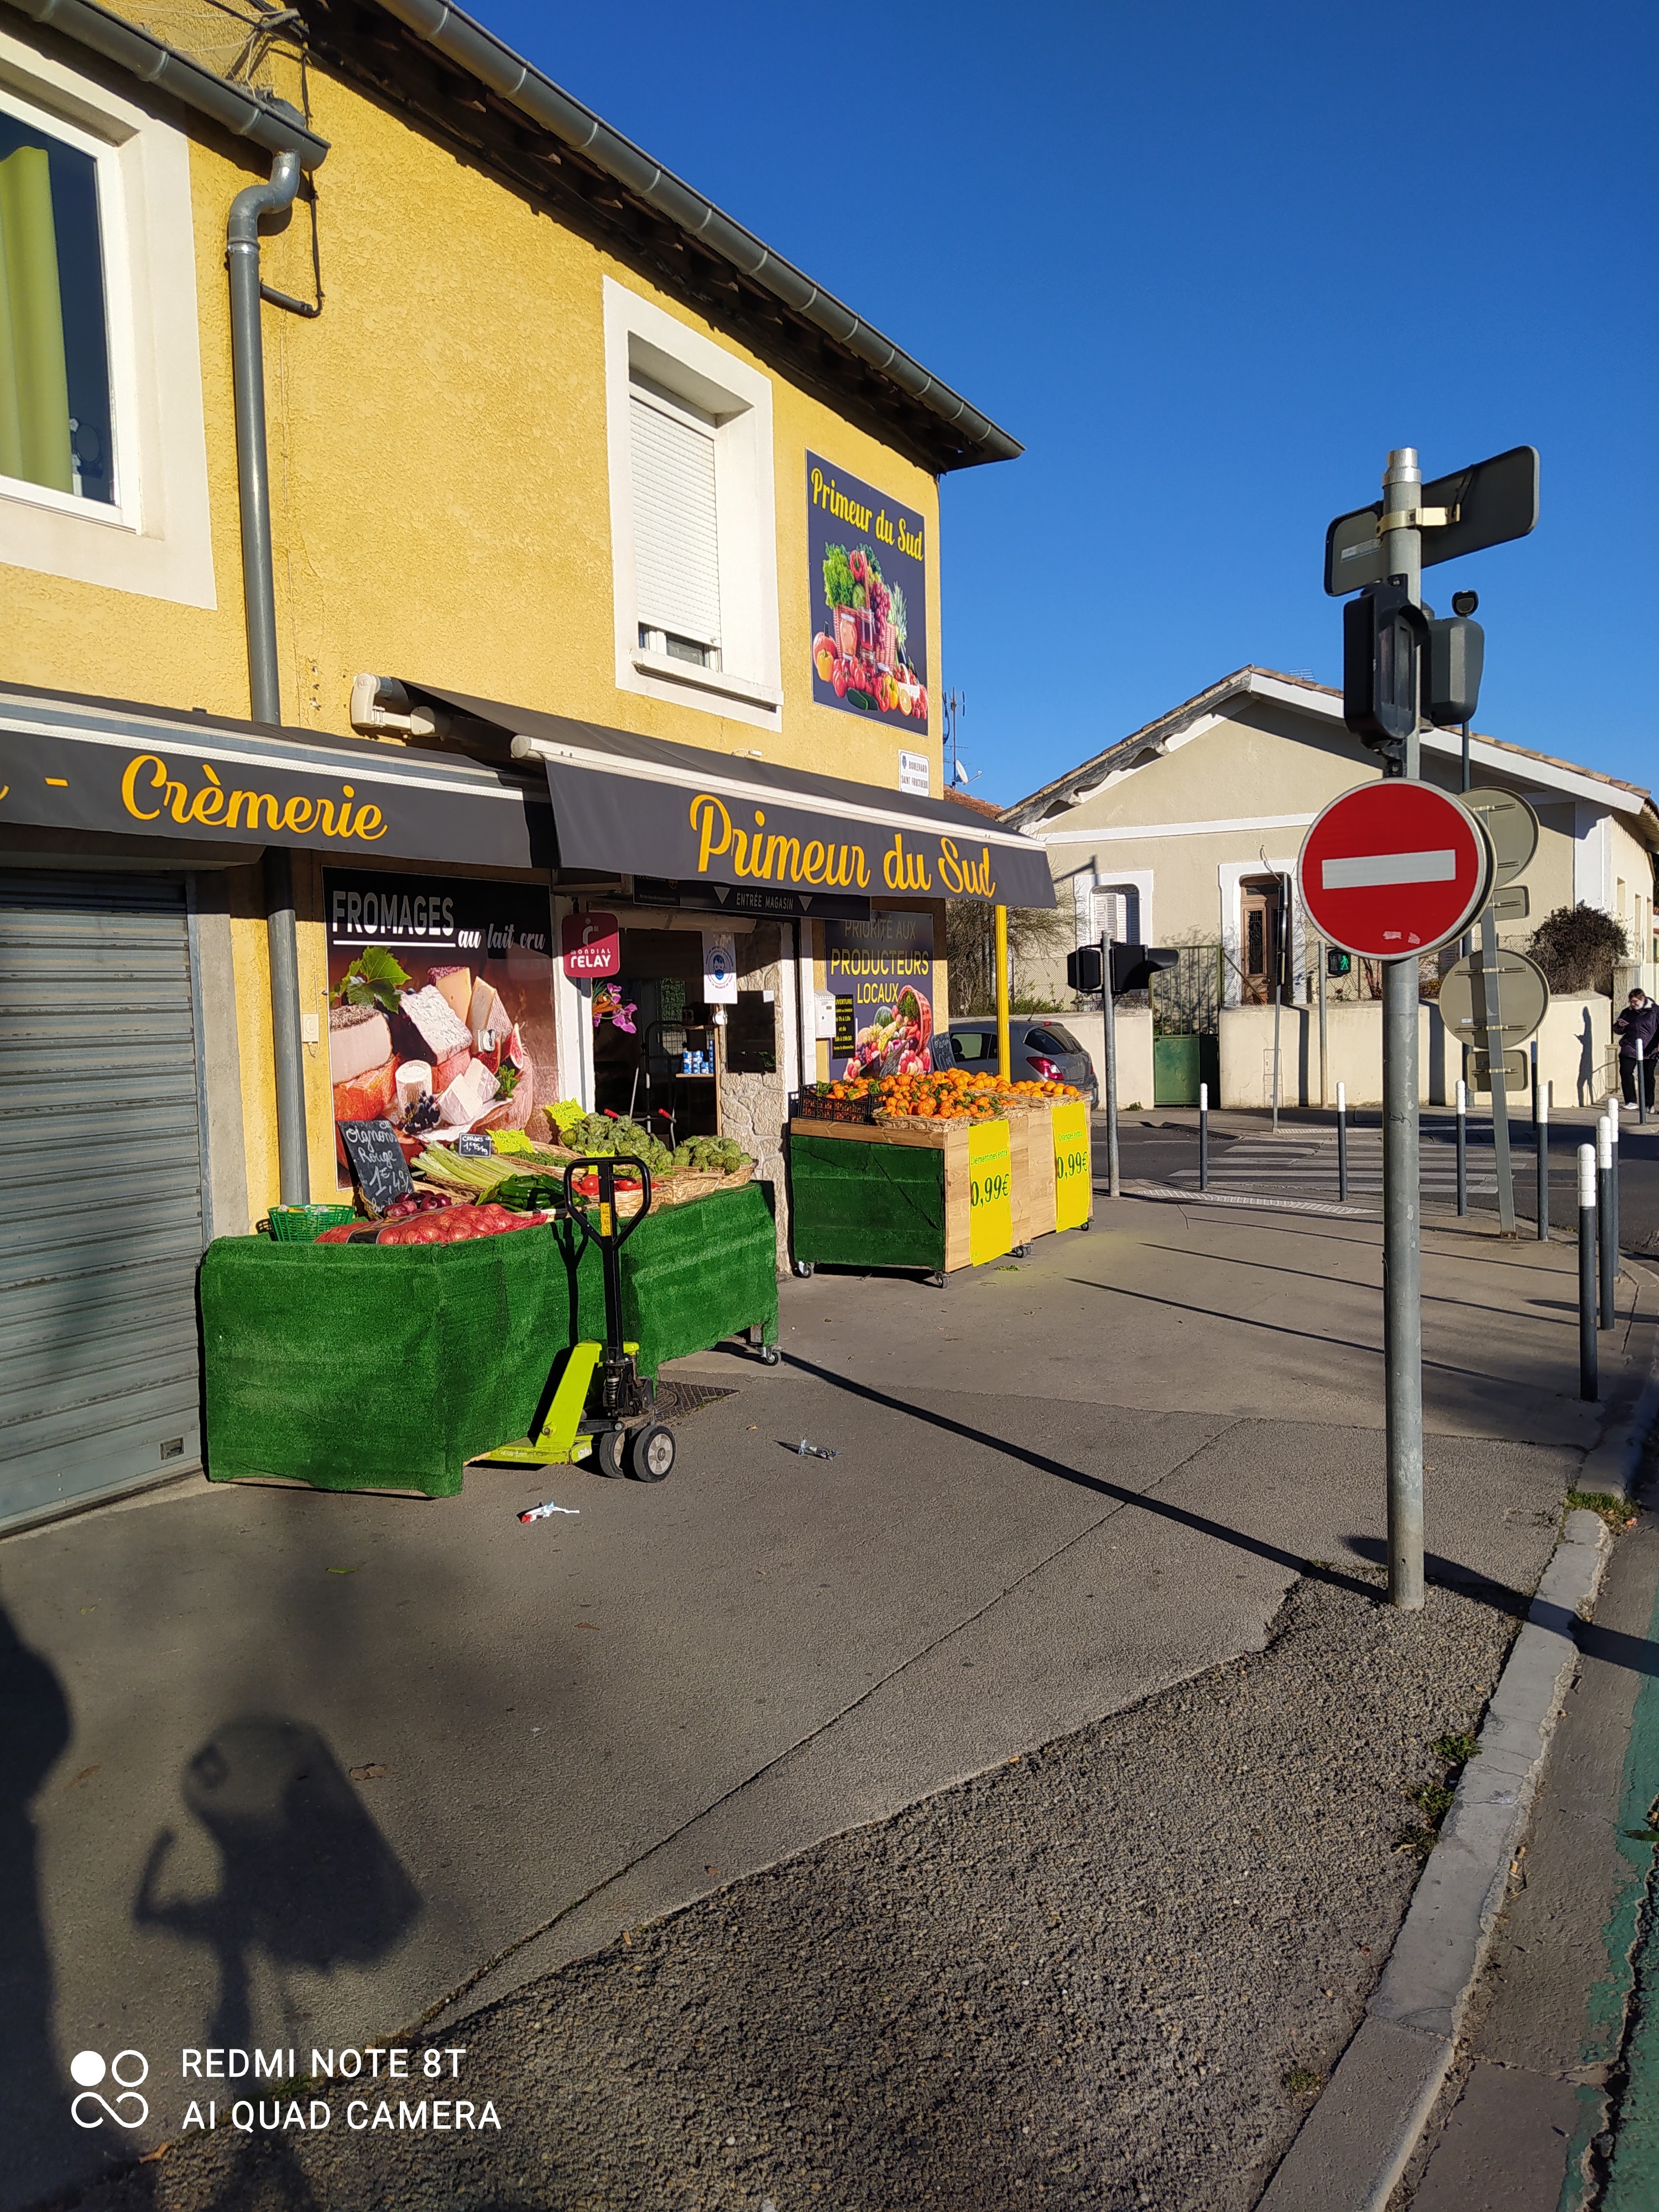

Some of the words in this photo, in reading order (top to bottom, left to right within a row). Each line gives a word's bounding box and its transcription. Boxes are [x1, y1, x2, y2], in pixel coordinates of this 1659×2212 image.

[811, 467, 873, 533] Primeur
[876, 509, 895, 546] du
[898, 518, 924, 561] Sud
[901, 775, 910, 785] SAINT
[909, 761, 927, 774] BOULEVARD
[122, 754, 388, 840] Crèmerie
[690, 794, 870, 888] Primeur
[884, 833, 931, 893] du
[938, 837, 995, 898] Sud
[736, 891, 762, 907] ENTRÉE
[765, 896, 794, 910] MAGASIN
[332, 890, 454, 936] FROMAGES
[458, 930, 482, 949] au
[487, 923, 514, 949] lait
[520, 932, 546, 950] cru
[844, 915, 893, 939] PRIORITÉ
[896, 921, 916, 940] AUX
[831, 948, 930, 975] PRODUCTEURS
[857, 983, 899, 1004] LOCAUX
[998, 1149, 1008, 1158] extra
[1057, 1151, 1088, 1181] 0,99€
[971, 1173, 1010, 1209] 0,99€
